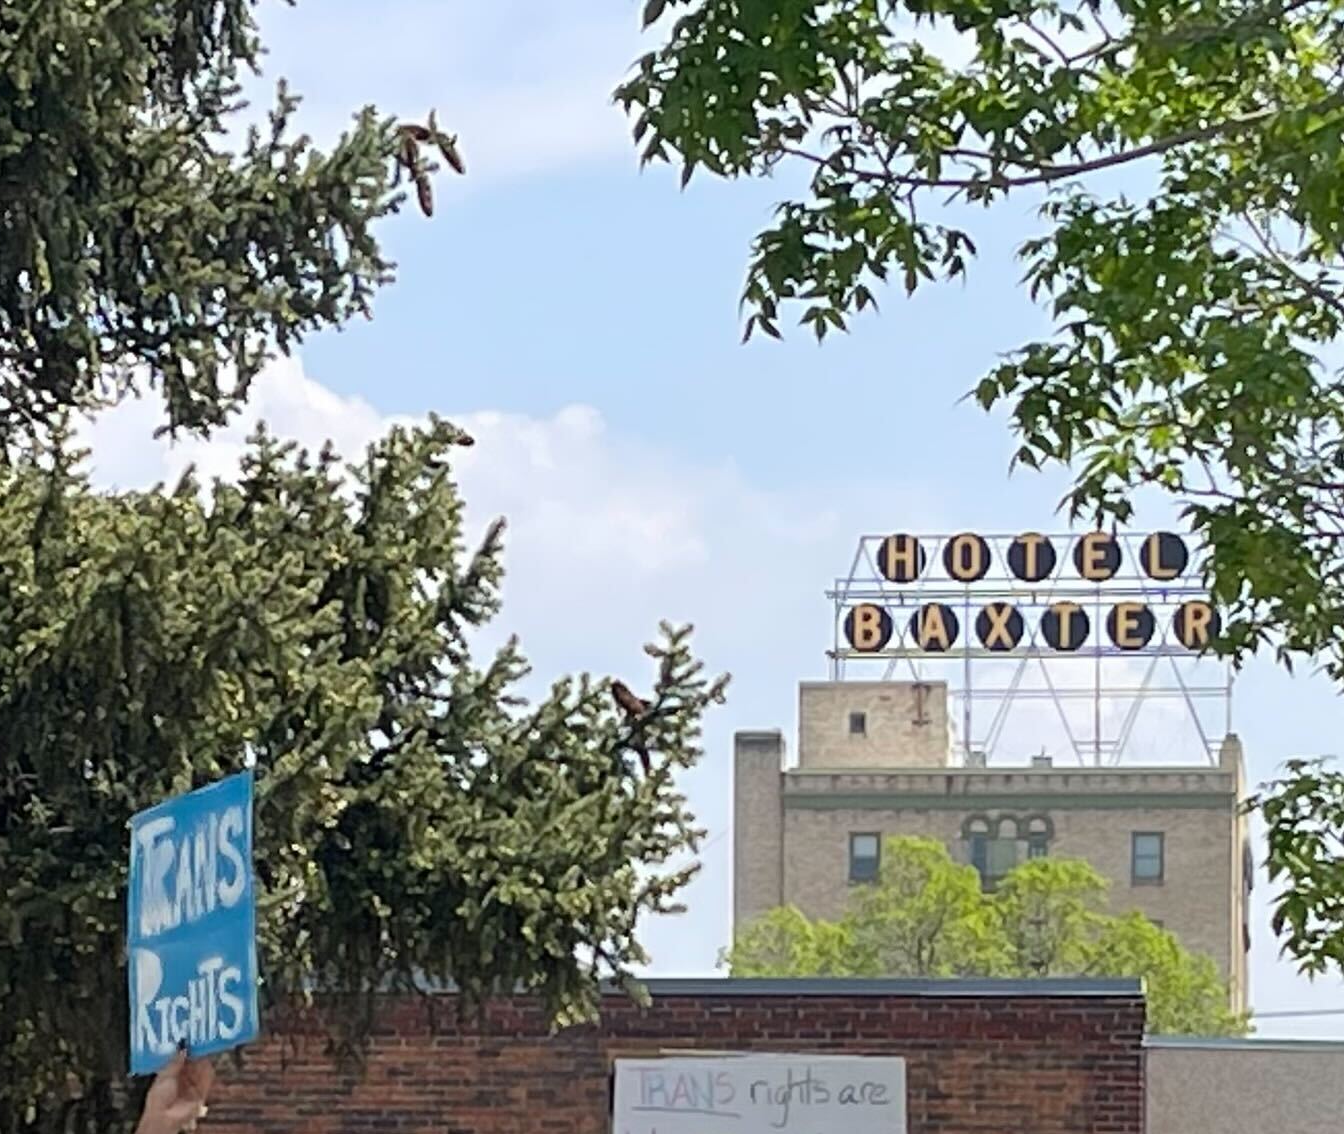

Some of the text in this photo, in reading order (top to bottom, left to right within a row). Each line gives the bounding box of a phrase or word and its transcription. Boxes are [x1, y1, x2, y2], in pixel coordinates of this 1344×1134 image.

[879, 533, 1188, 581] HOTEL
[846, 602, 1220, 651] BAXTER
[136, 805, 246, 937] TRANS
[135, 948, 244, 1054] RIGHTS
[627, 1066, 891, 1128] TRANS rights are
